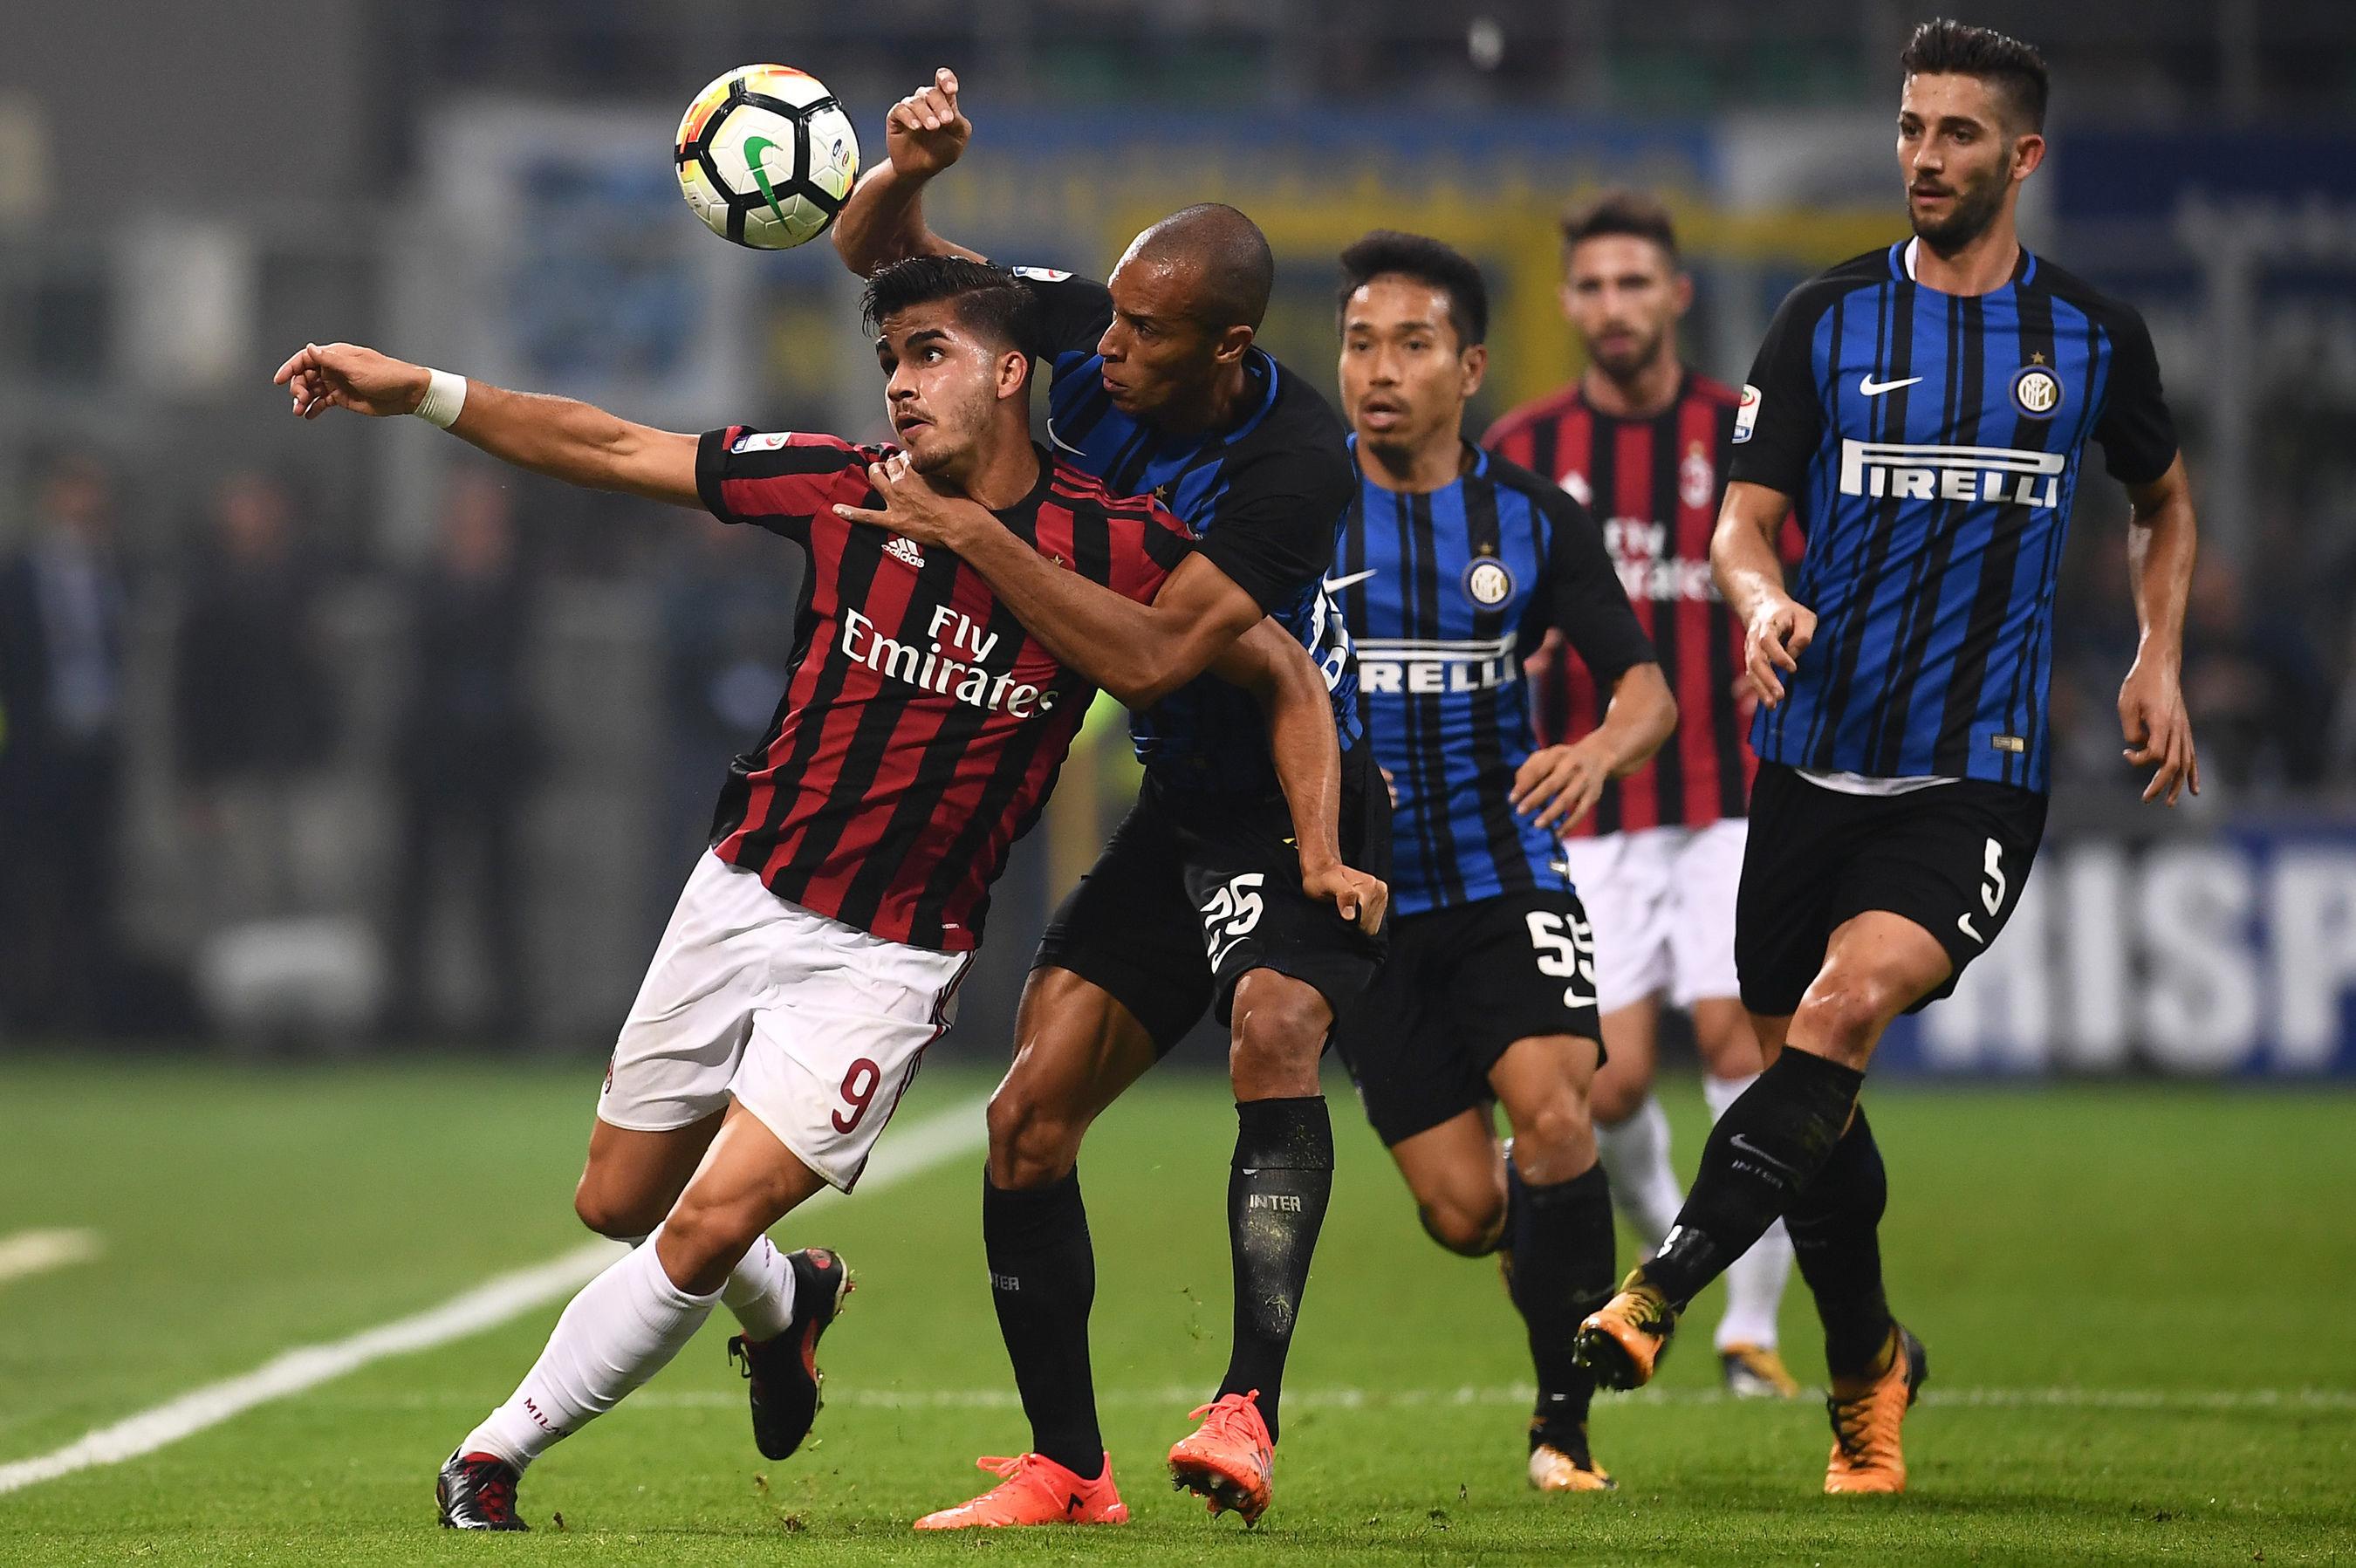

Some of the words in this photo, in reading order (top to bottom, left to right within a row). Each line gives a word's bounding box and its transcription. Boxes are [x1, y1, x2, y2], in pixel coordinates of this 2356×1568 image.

[1839, 437, 2065, 509] PIRELLI
[881, 544, 925, 568] adidas
[841, 607, 1059, 719] Emirates
[927, 604, 999, 663] Fly
[1352, 631, 1518, 694] RELLI
[1981, 837, 2007, 917] 5
[1199, 873, 1265, 959] 25
[831, 1058, 881, 1134] 9
[1249, 1194, 1302, 1213] INTER
